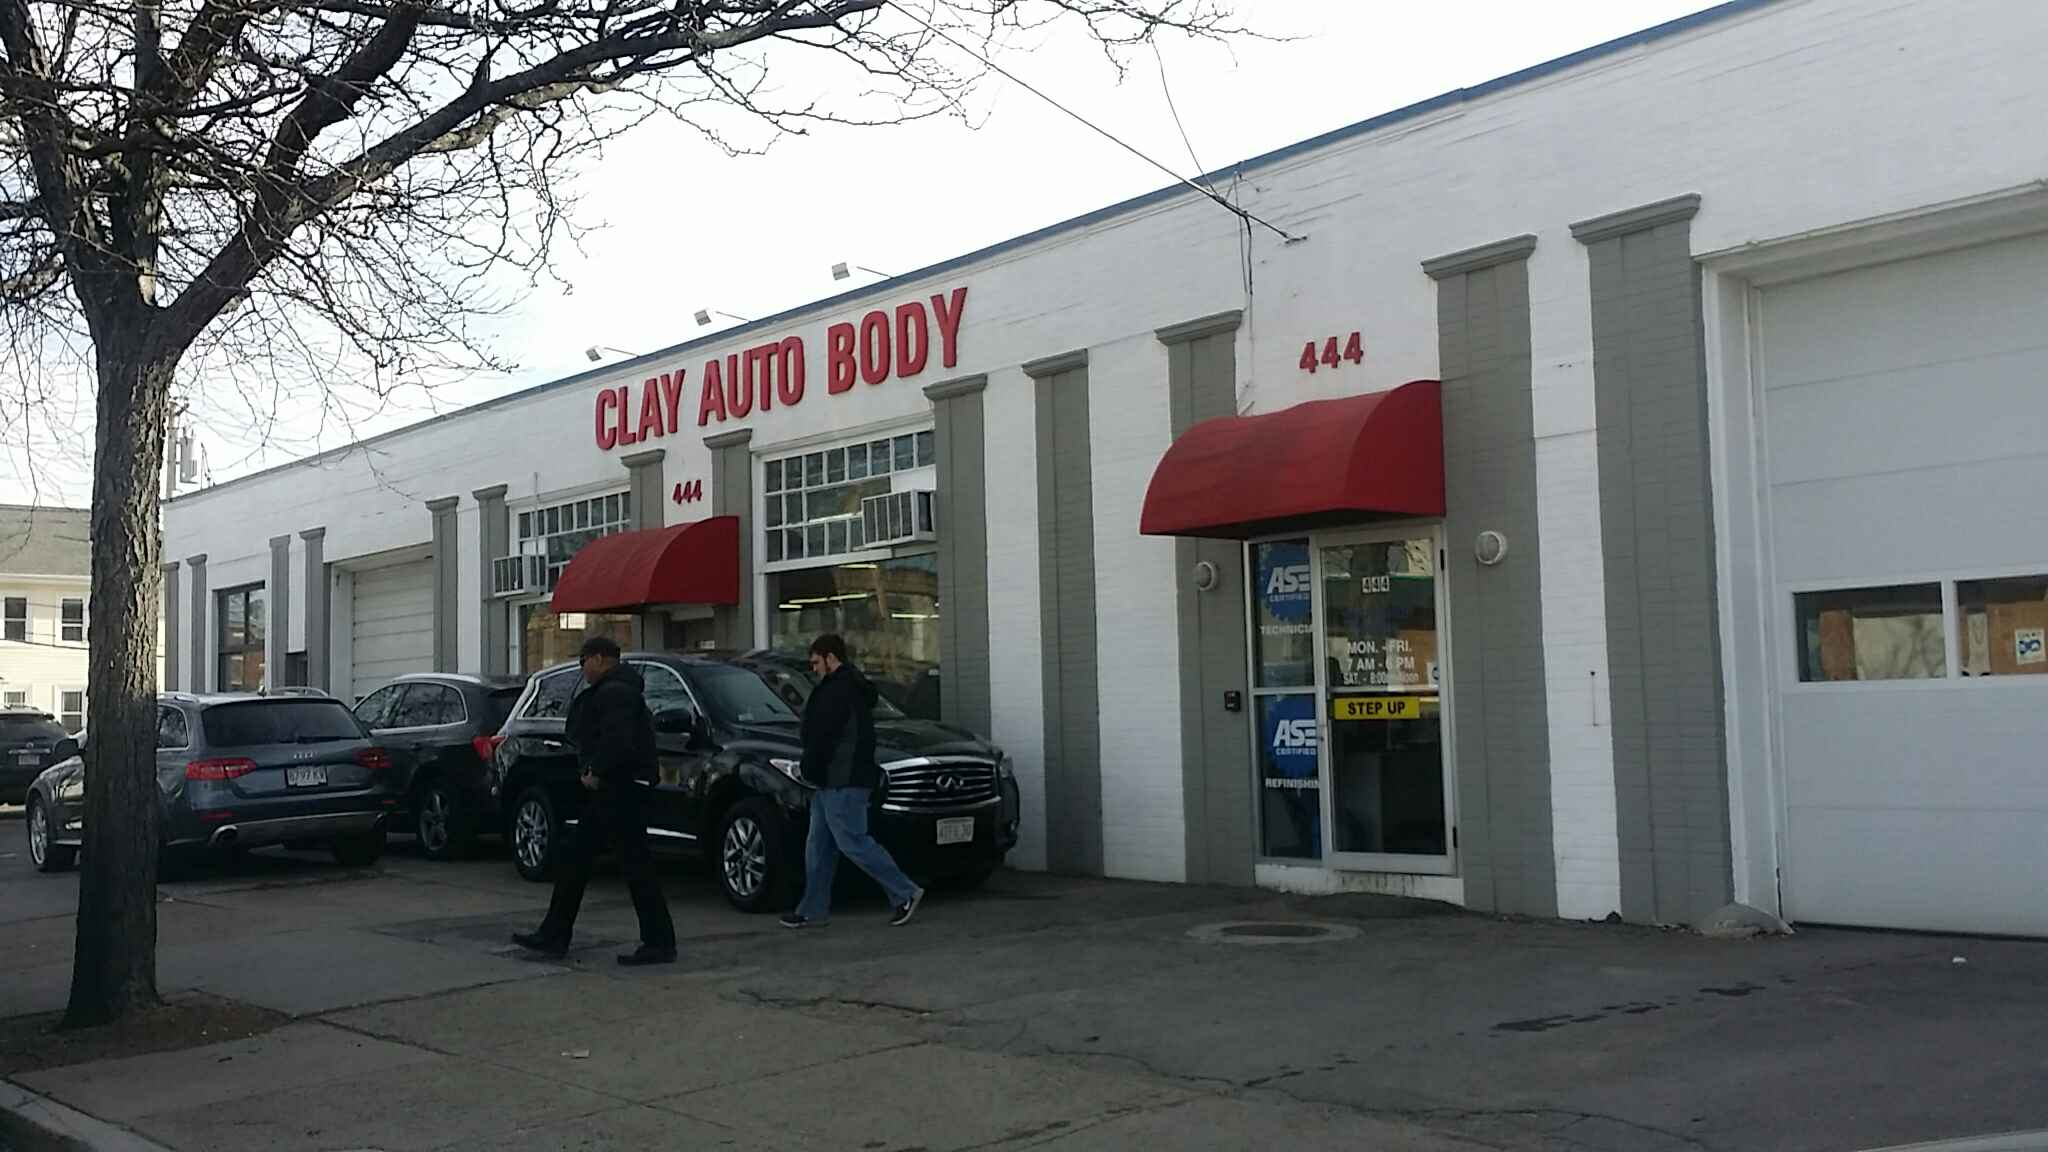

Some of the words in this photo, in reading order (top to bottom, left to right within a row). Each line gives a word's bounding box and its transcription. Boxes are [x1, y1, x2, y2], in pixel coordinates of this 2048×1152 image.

[1299, 331, 1364, 374] 444
[595, 368, 685, 450] CLAY
[697, 336, 805, 426] AUTO
[828, 287, 968, 395] BODY
[672, 480, 703, 505] 444
[1266, 564, 1311, 594] ASE
[1356, 657, 1376, 671] AM
[1396, 655, 1415, 669] PM
[1347, 702, 1383, 716] STEP
[1387, 701, 1406, 715] UP
[1272, 719, 1317, 747] ASE
